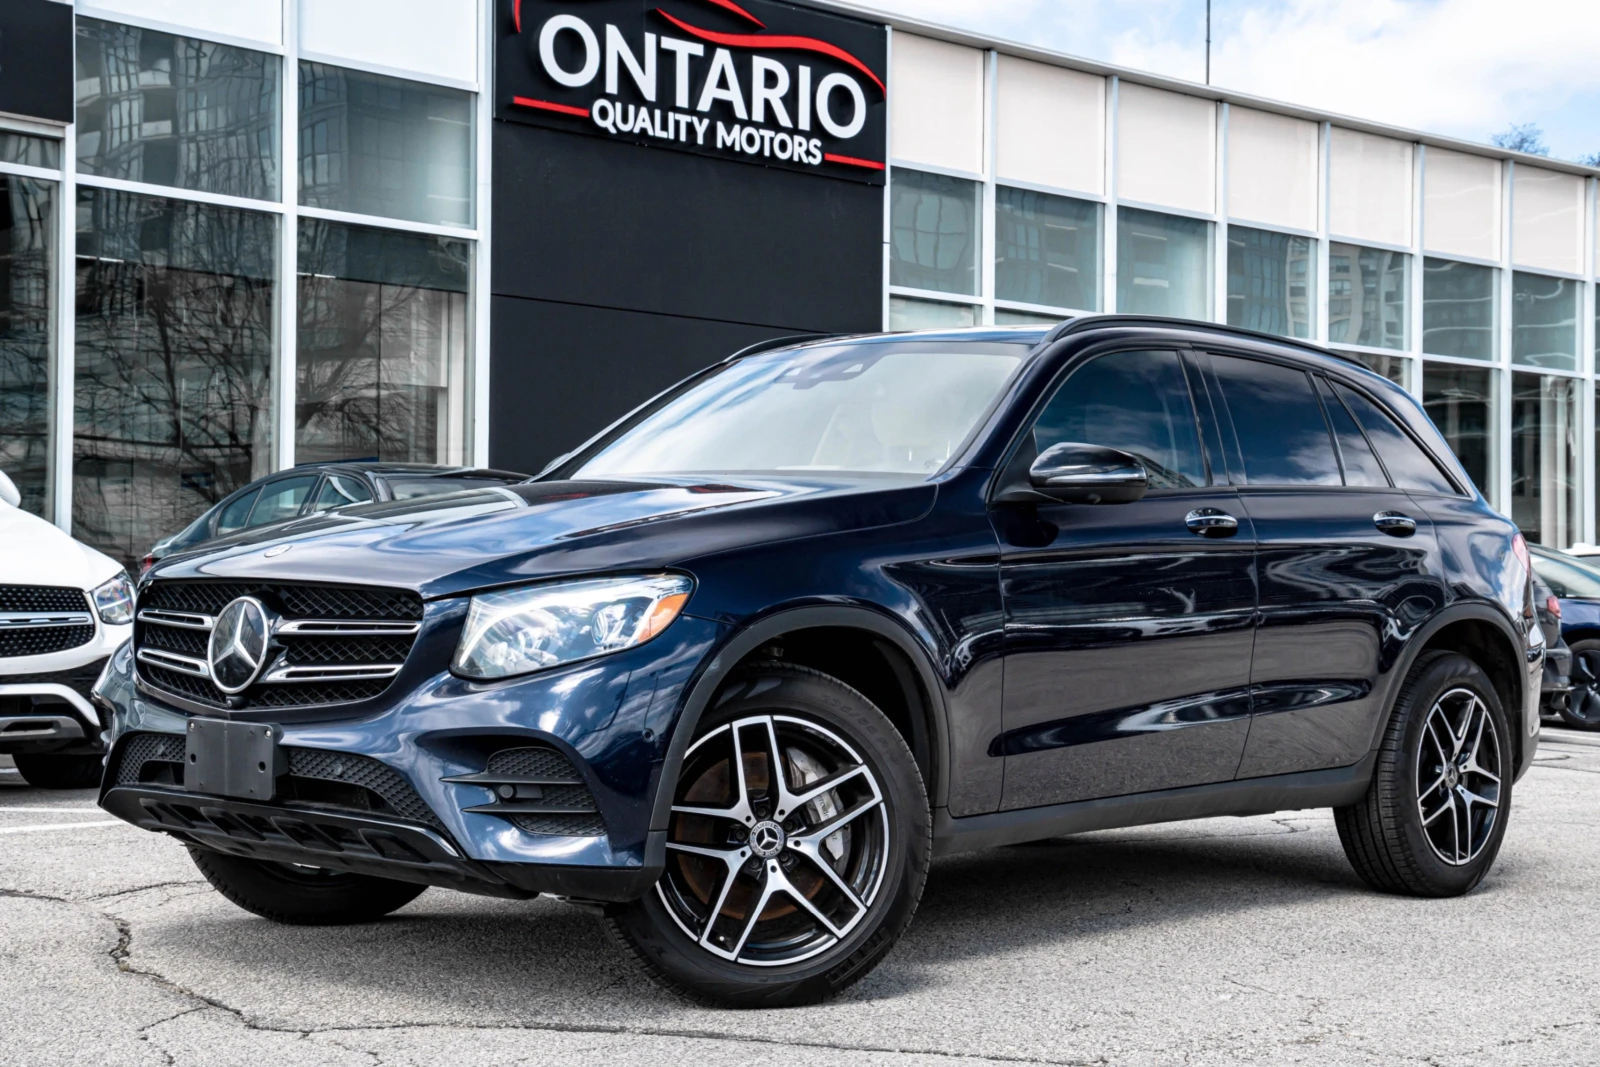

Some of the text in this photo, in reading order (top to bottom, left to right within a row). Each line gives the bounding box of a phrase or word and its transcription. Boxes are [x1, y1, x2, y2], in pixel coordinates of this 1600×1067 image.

[538, 14, 867, 139] ONTARIO
[592, 99, 822, 165] QUALITY MOTORS
